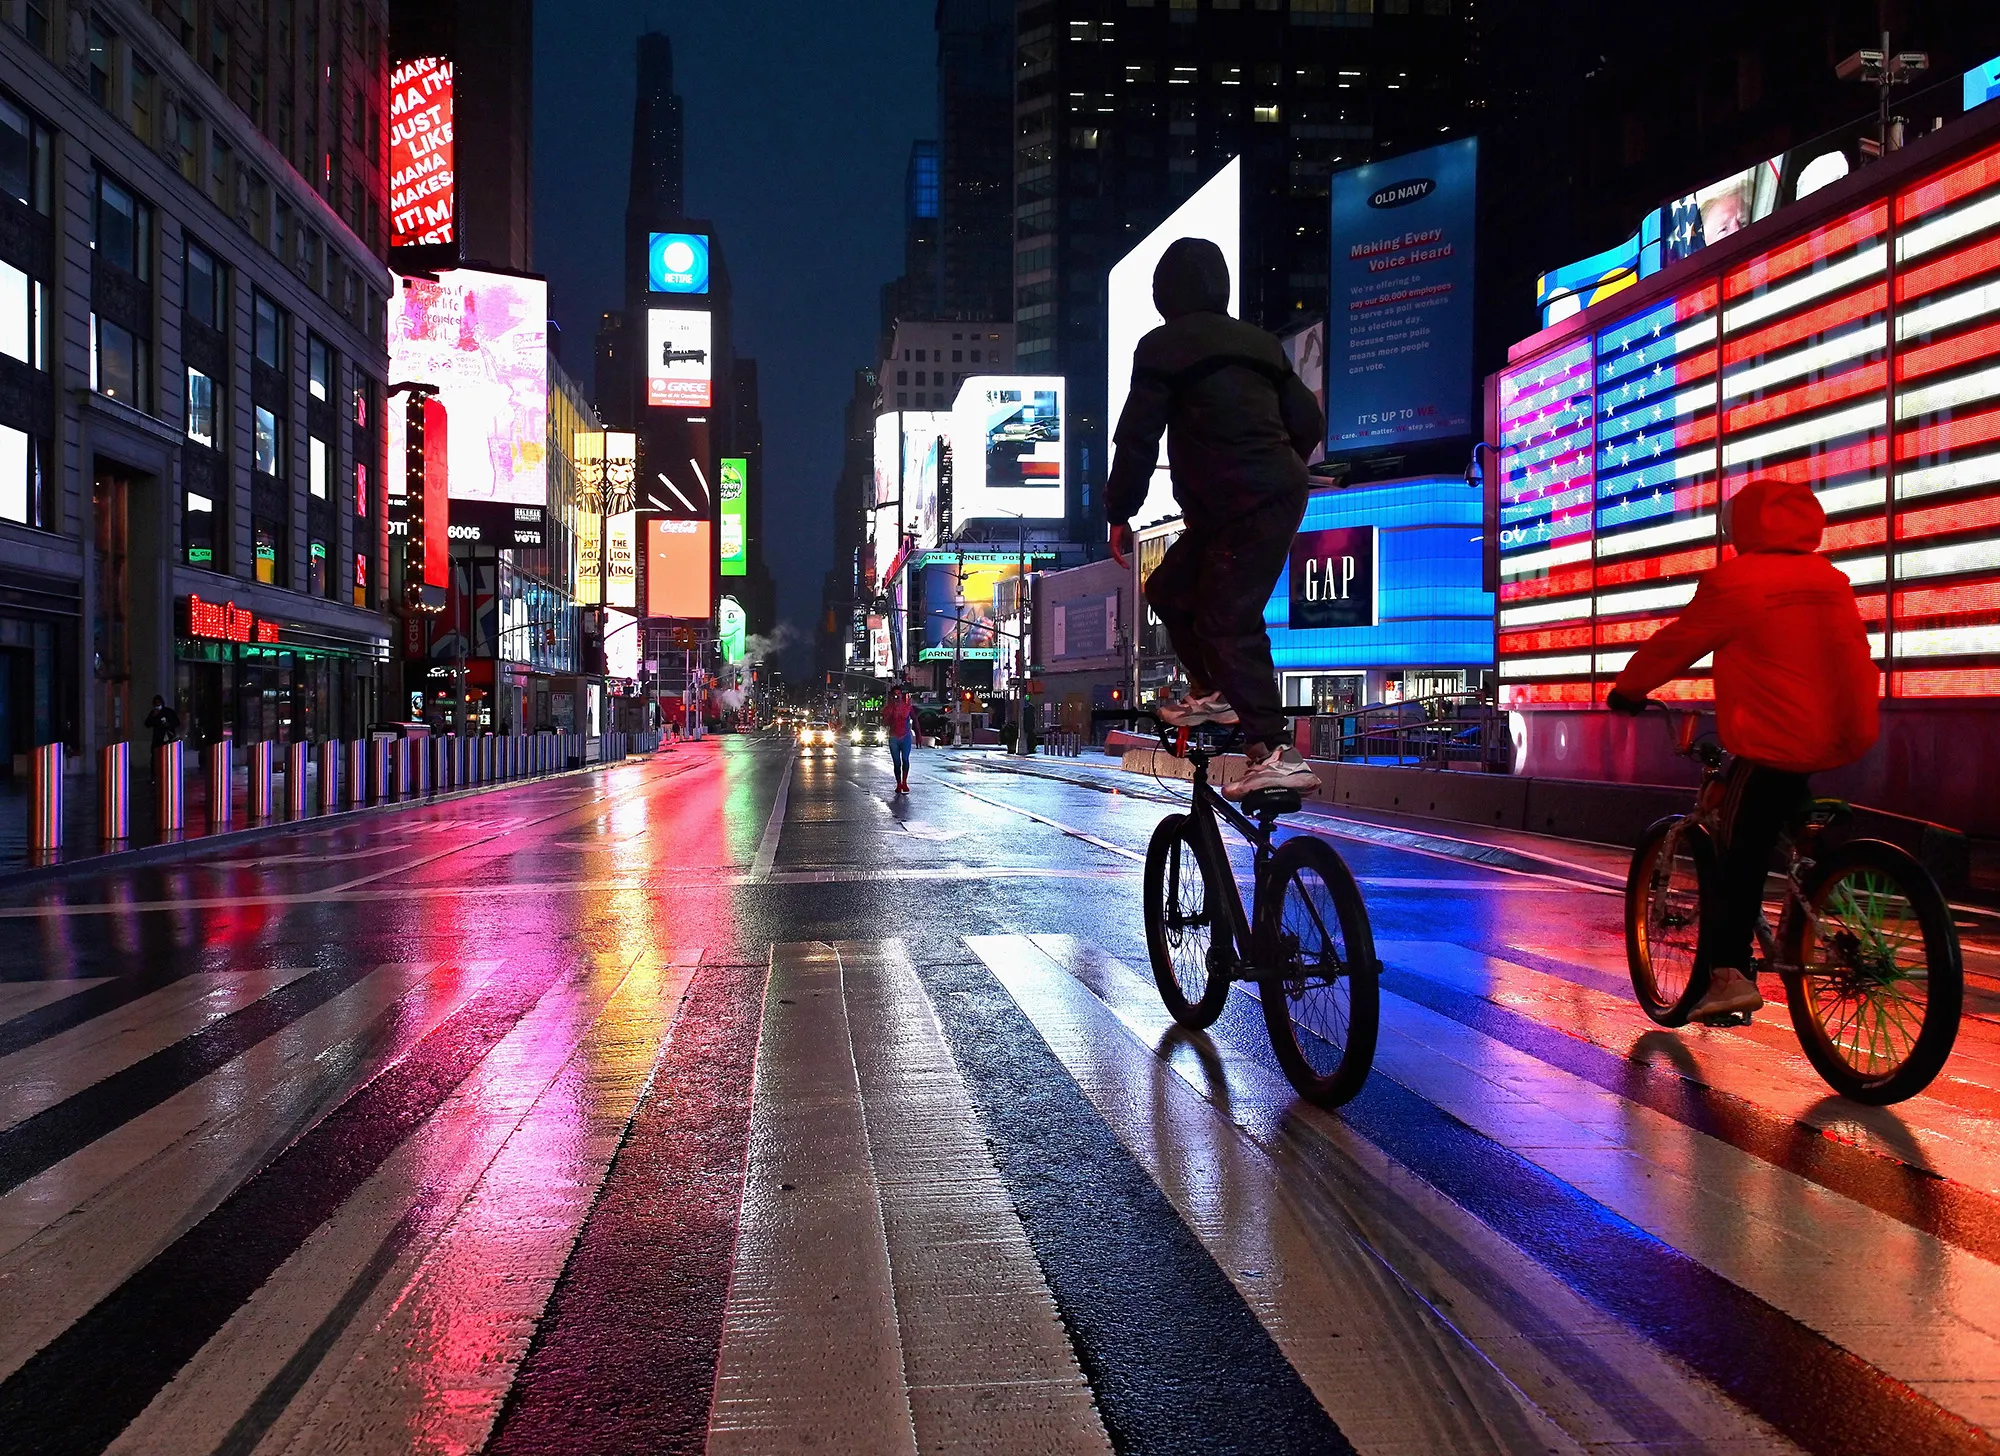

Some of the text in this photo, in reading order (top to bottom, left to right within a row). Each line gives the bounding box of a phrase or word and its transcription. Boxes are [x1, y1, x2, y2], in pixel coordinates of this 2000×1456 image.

[391, 104, 441, 146] JUST
[408, 122, 453, 159] LIKE
[391, 153, 446, 190] MAMA
[391, 171, 452, 212] MAKES
[1375, 182, 1428, 204] OLD NAVY
[394, 206, 424, 234] IT!
[1351, 228, 1442, 257] Making Every
[1369, 243, 1452, 272] Voice Heard
[1350, 285, 1374, 295] We're
[1376, 278, 1410, 290] offering
[1350, 301, 1363, 310] pay
[1379, 290, 1408, 302] 50,000
[1409, 282, 1452, 297] employees
[417, 298, 459, 311] your life
[1360, 309, 1384, 320] serve
[1396, 302, 1412, 314] poll
[1414, 297, 1449, 308] workers
[1350, 326, 1366, 334] this
[1368, 319, 1403, 332] election
[1350, 327, 1430, 348] Because more polls
[1350, 341, 1430, 360] means more people
[1349, 362, 1386, 374] can vote.
[668, 382, 706, 392] GREE
[1358, 414, 1378, 425] IT'S
[1381, 411, 1396, 422] UP
[1399, 408, 1414, 419] TO
[1370, 428, 1395, 436] matter.
[1408, 423, 1424, 431] step
[448, 525, 480, 540] 6005
[514, 534, 540, 544] VOTE
[610, 549, 630, 561] LION
[608, 562, 634, 577] KING
[1306, 556, 1354, 602] GAP
[410, 619, 418, 641] CBS
